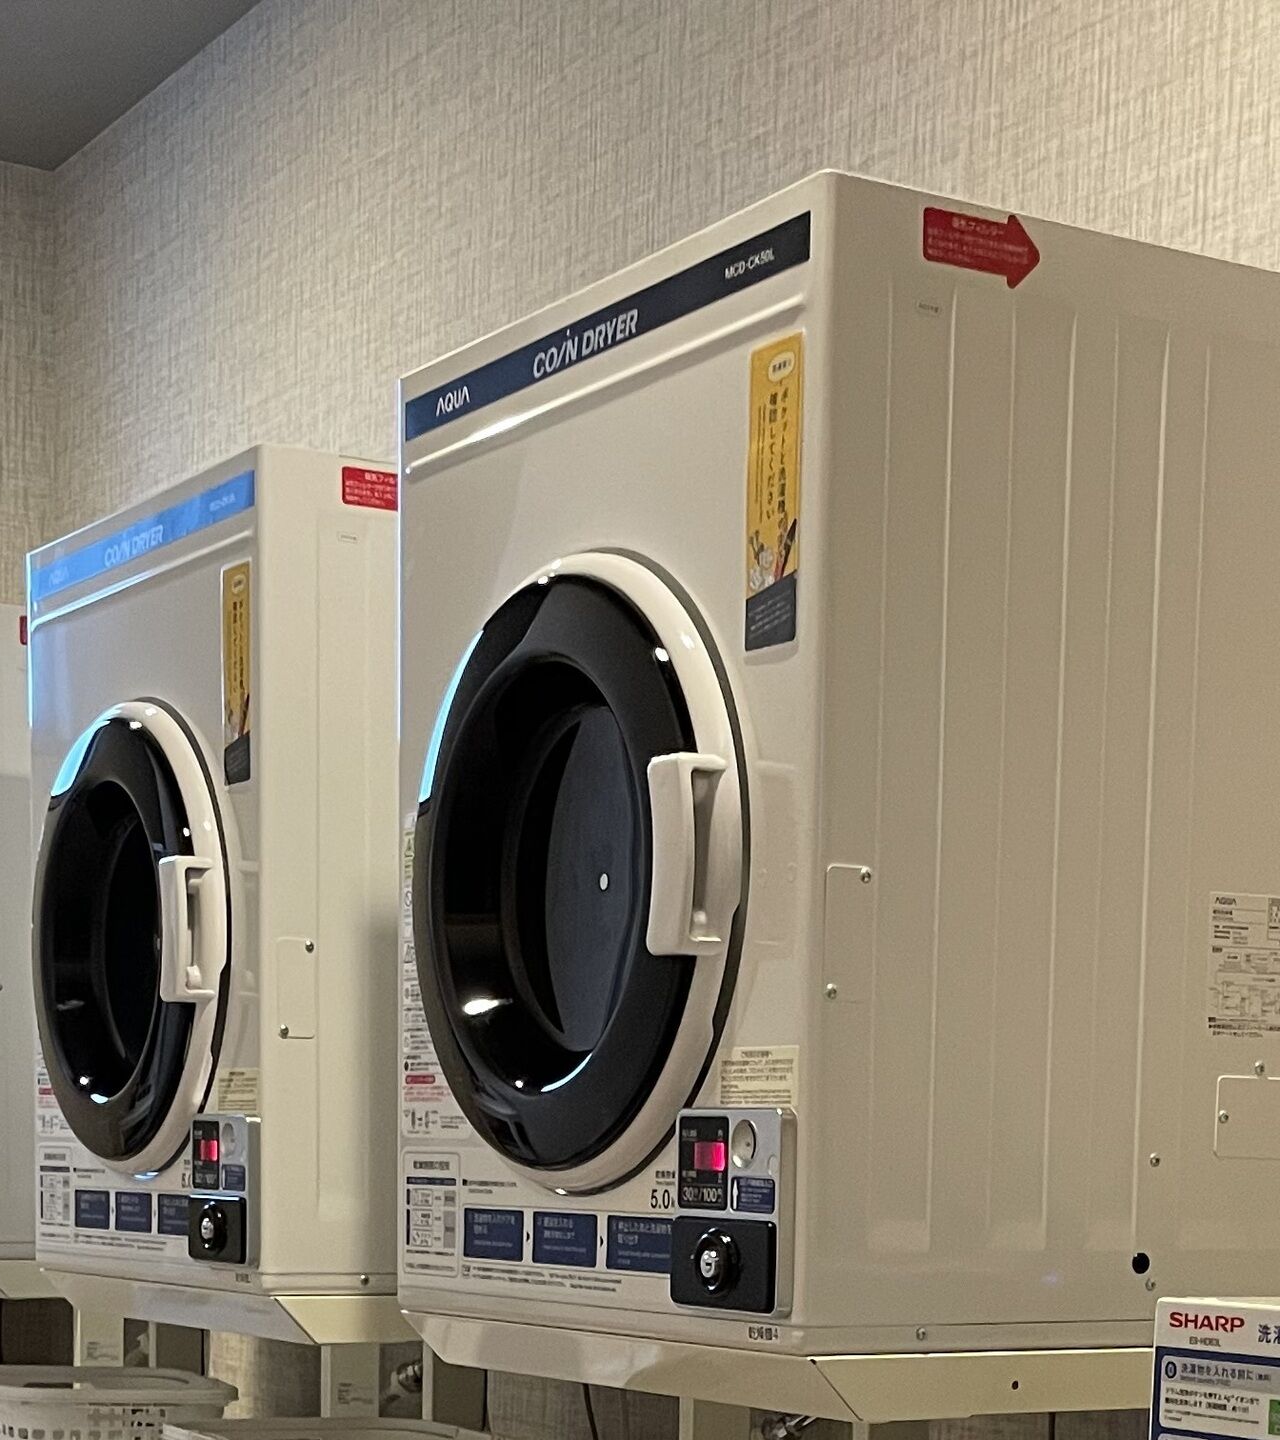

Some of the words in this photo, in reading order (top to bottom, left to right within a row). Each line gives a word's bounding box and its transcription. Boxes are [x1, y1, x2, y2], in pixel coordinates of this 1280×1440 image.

[533, 329, 579, 379] COIN
[581, 308, 639, 358] DRYER
[436, 386, 470, 417] AQUA
[650, 1188, 670, 1209] 5.0
[1169, 1312, 1245, 1333] SHARP
